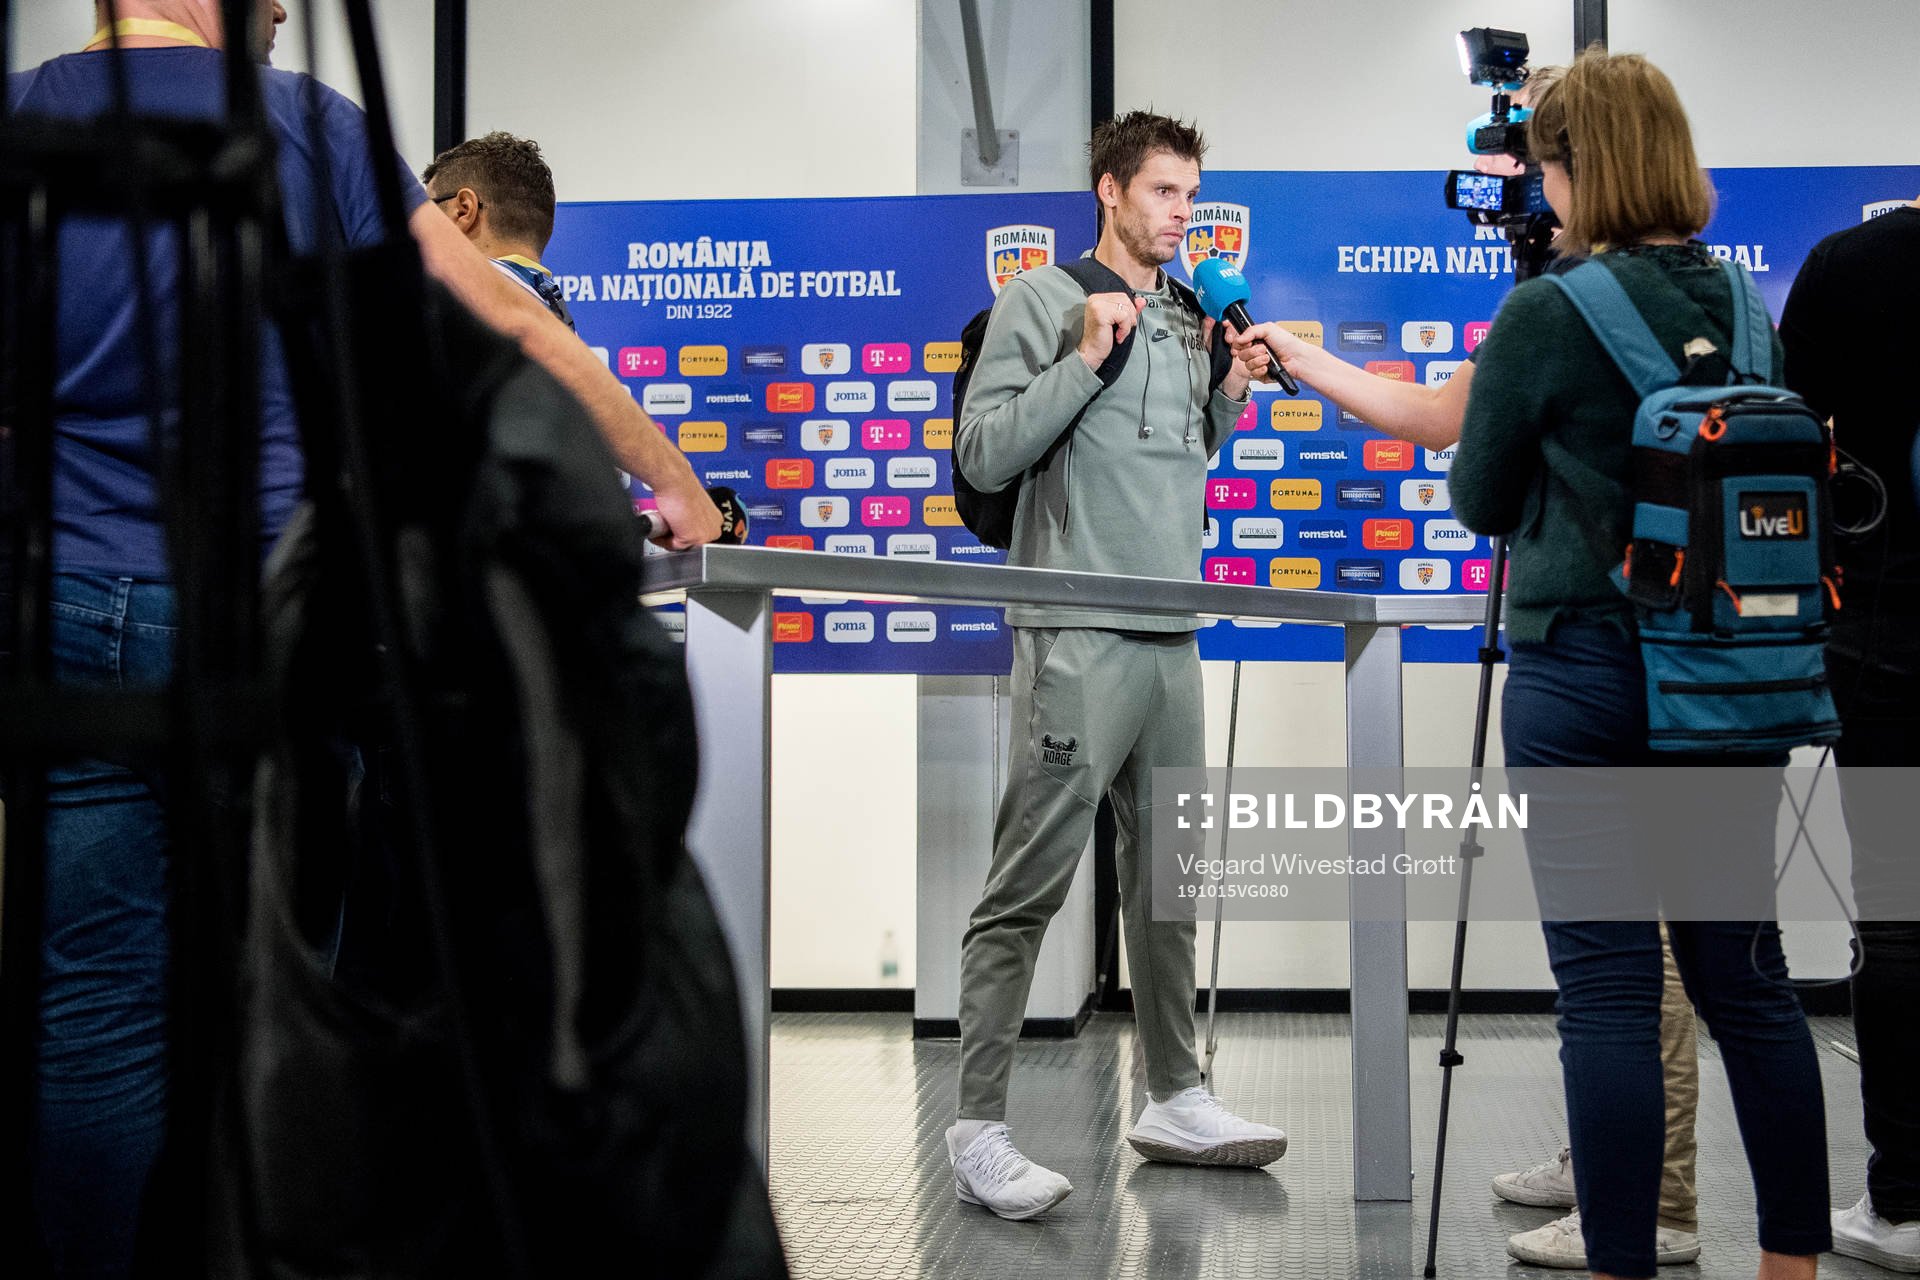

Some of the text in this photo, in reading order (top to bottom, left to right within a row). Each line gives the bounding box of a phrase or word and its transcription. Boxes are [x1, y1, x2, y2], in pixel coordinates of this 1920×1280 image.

[627, 236, 772, 270] ROMÂNIA
[994, 229, 1047, 247] ROMÂNIA
[1337, 246, 1517, 280] ECHIPA NAȚI
[601, 267, 757, 307] NAȚIONALĂ
[760, 271, 795, 298] DE
[800, 270, 902, 298] FOTBAL
[666, 304, 733, 319] DIN 1922
[721, 500, 734, 533] TVR
[1740, 505, 1804, 536] LiveU
[1042, 749, 1073, 766] NORGE
